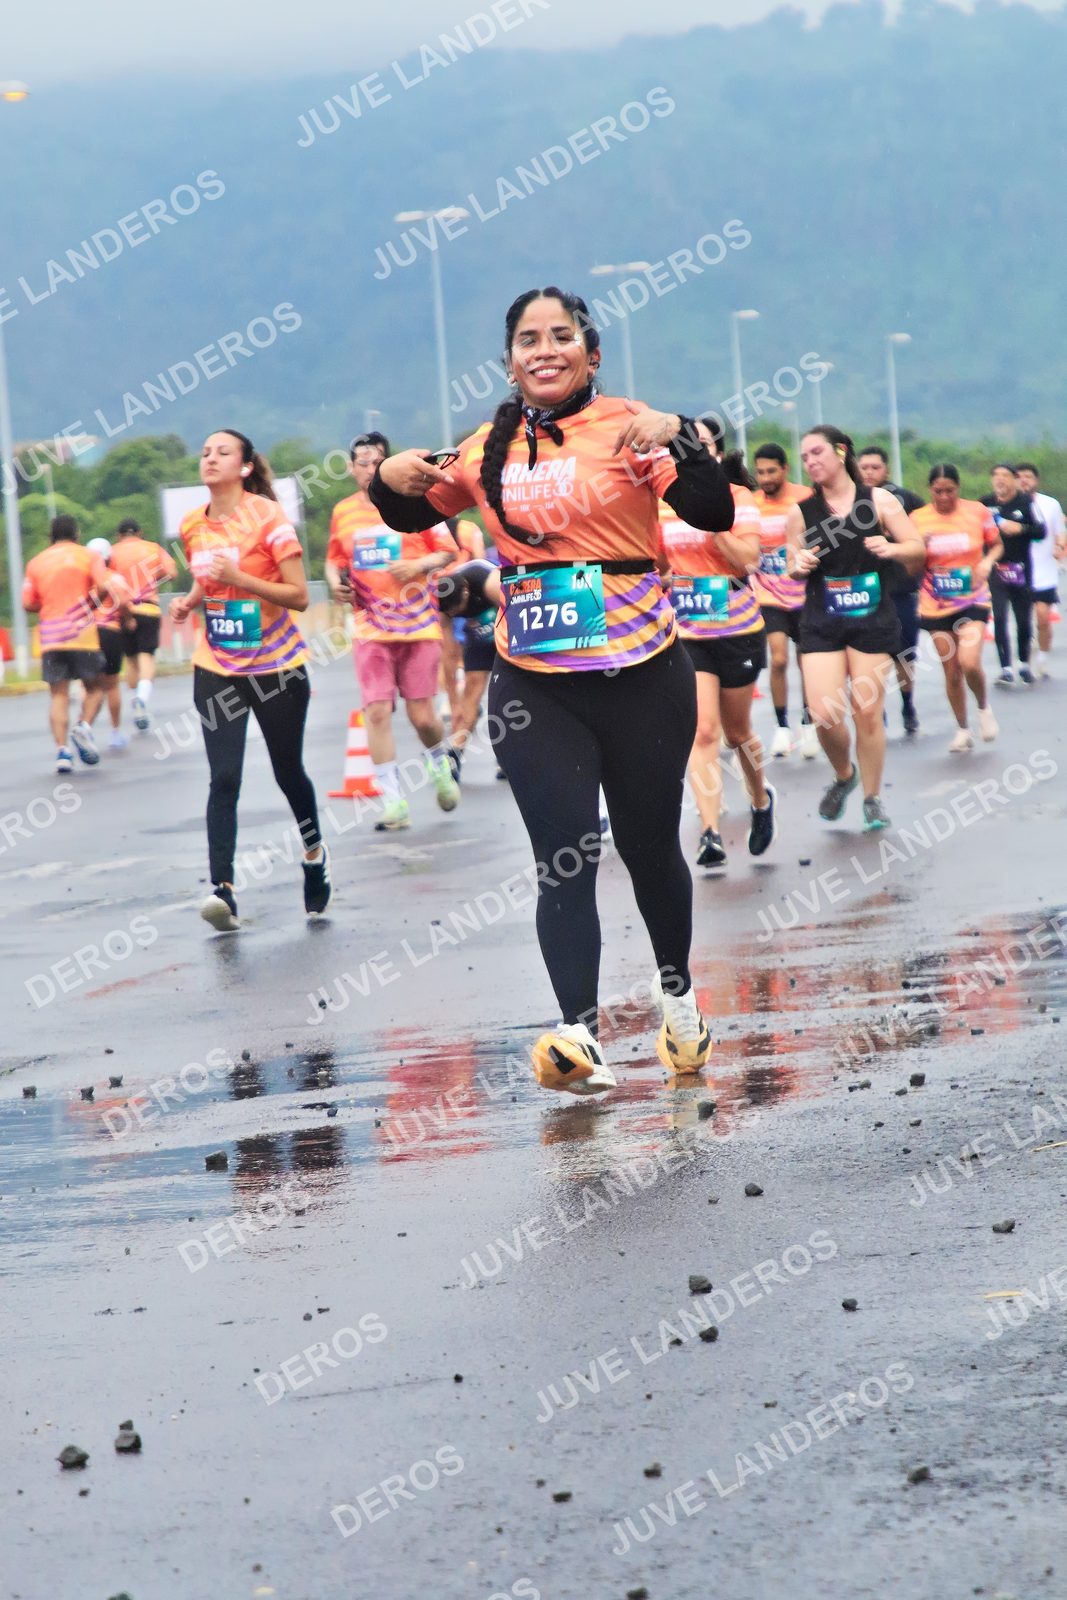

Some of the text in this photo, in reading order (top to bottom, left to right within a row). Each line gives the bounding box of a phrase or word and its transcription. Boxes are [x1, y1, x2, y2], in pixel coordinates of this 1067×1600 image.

[677, 594, 712, 609] 1417
[835, 591, 870, 607] 1600
[519, 602, 578, 631] 1276
[211, 618, 244, 636] 1281
